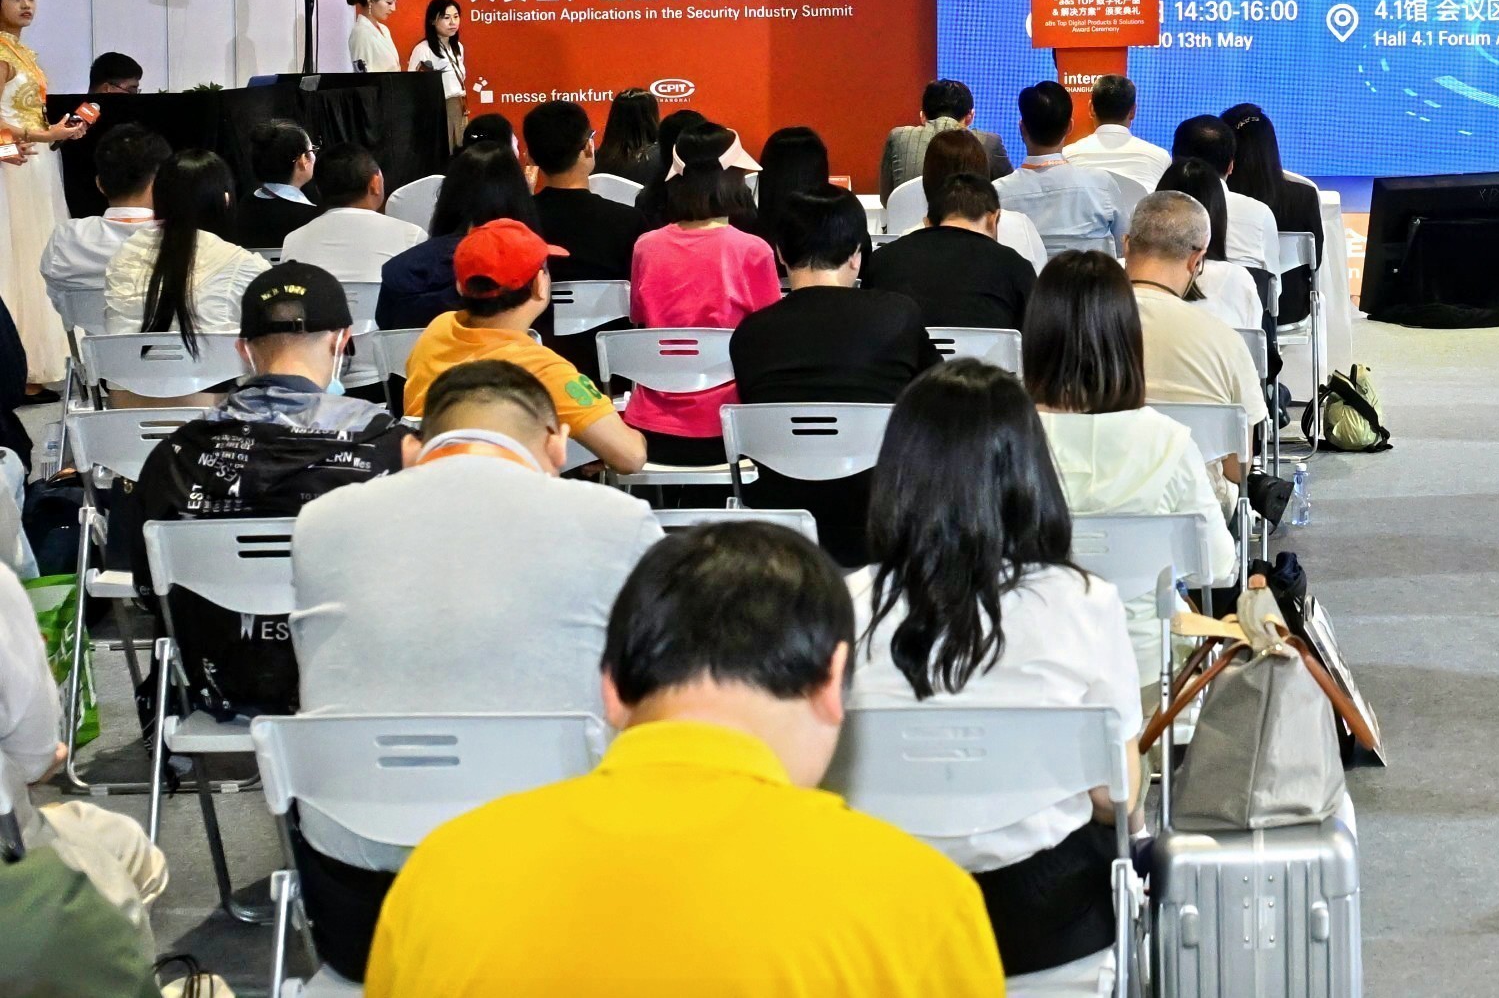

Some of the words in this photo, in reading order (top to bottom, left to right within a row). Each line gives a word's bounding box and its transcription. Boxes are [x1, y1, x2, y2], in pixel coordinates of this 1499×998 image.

[470, 9, 556, 25] Digitalisation
[560, 8, 642, 23] Applications
[645, 8, 657, 19] in
[662, 7, 683, 18] the
[687, 6, 739, 20] Security
[745, 5, 798, 19] Industry
[802, 5, 853, 17] Summit
[1174, 0, 1299, 22] 14:30-16:00
[1057, 20, 1067, 28] Top
[1068, 20, 1086, 28] Digital
[1177, 32, 1212, 48] 13th
[1217, 32, 1253, 50] May
[1374, 31, 1406, 46] Hall
[1412, 31, 1433, 45] 4.1
[1438, 31, 1491, 45] Forum
[501, 90, 547, 103] messe
[551, 88, 613, 102] frankfurt
